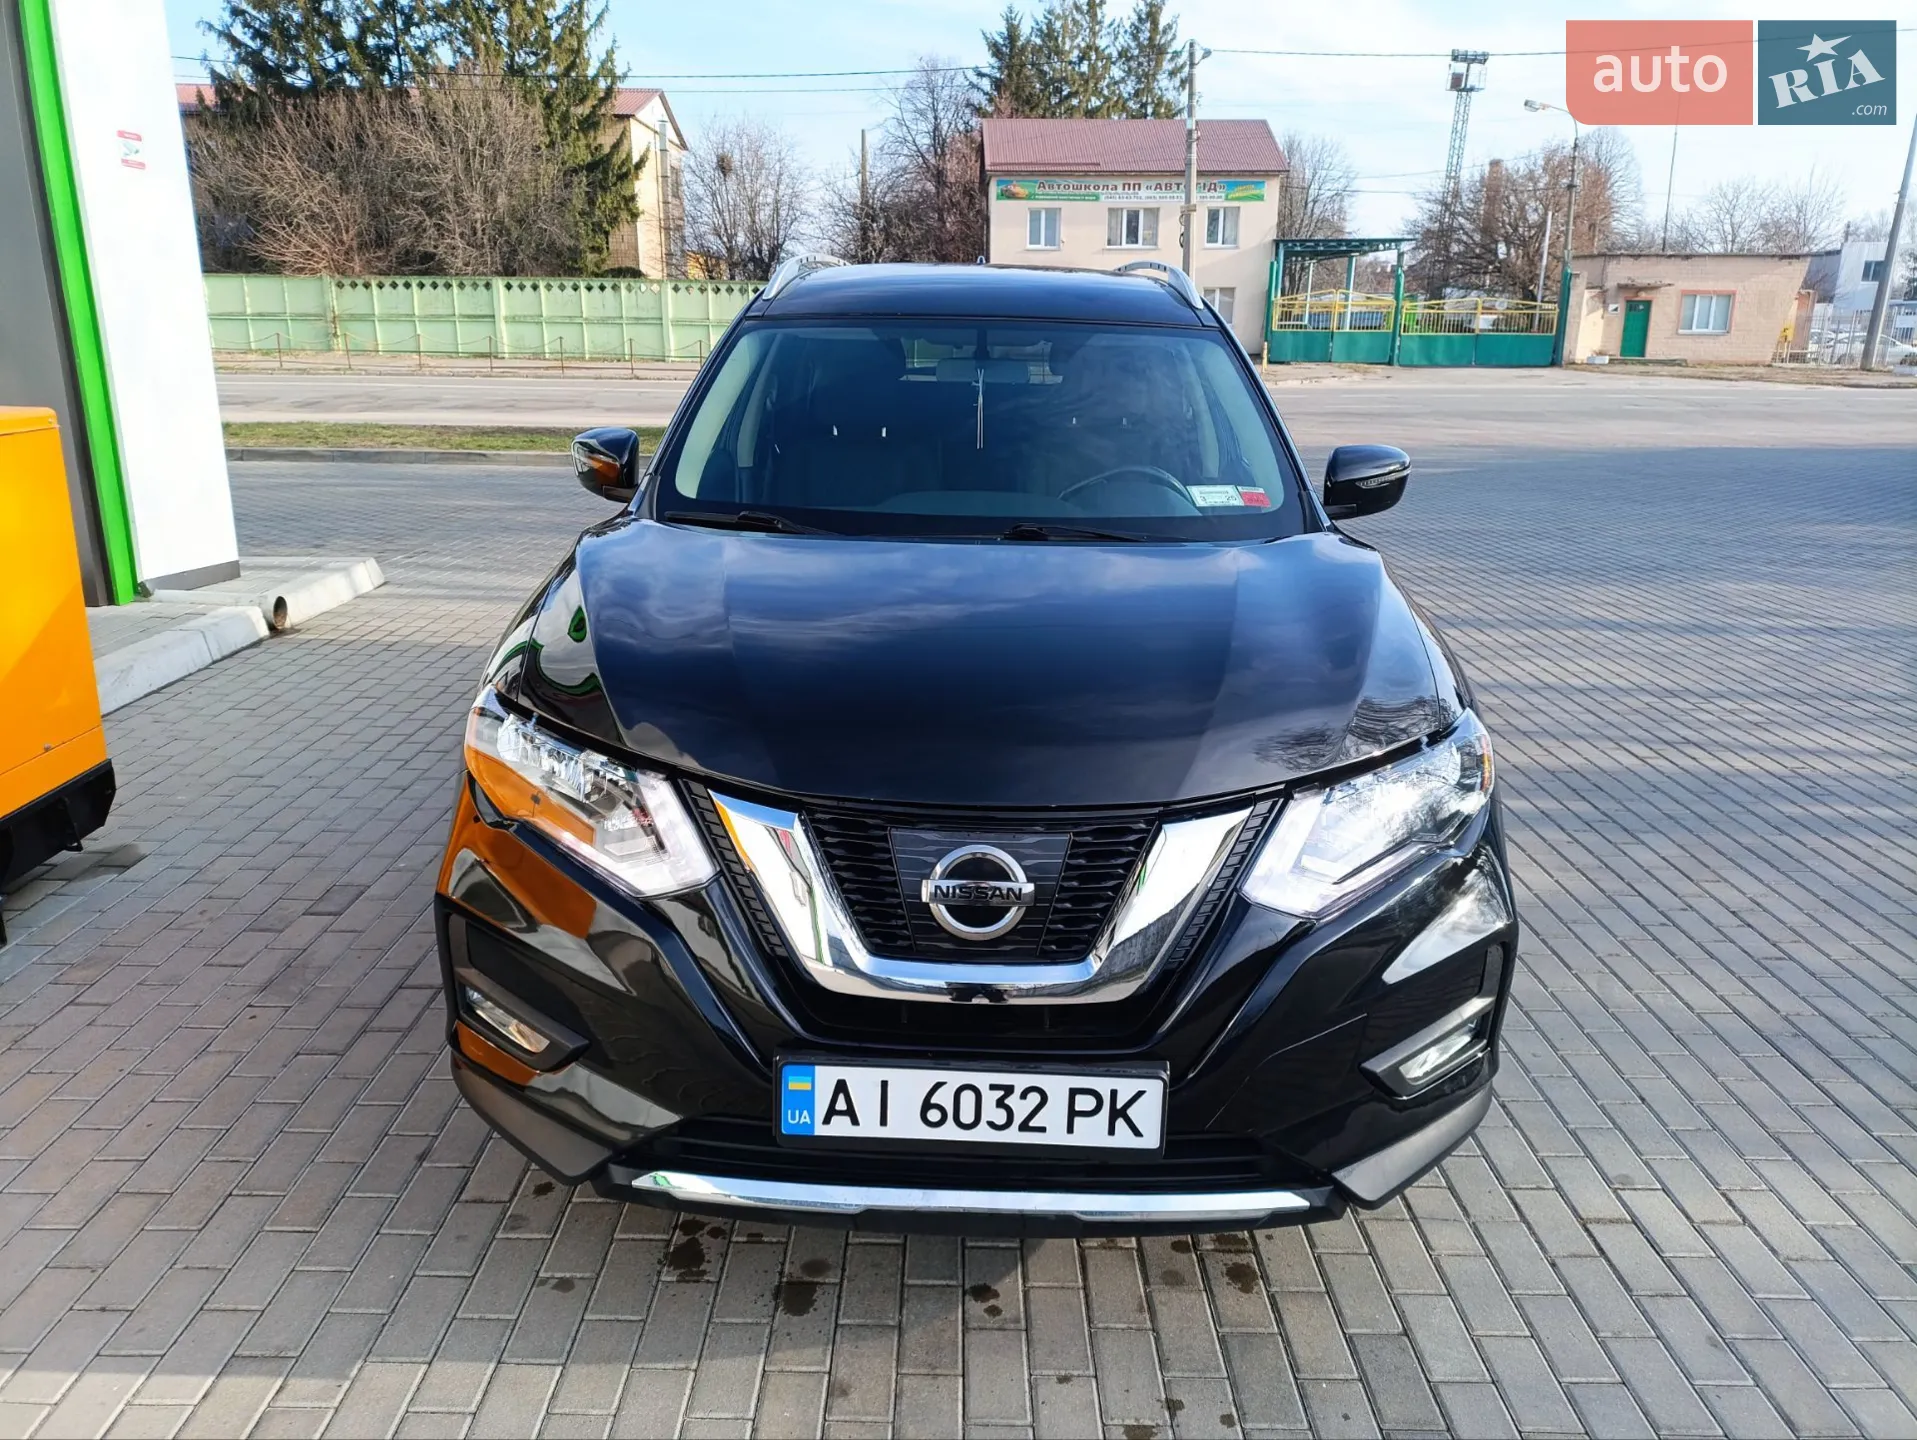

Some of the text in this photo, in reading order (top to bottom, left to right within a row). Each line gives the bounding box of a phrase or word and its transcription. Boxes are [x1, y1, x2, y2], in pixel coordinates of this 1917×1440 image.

[1037, 181, 1118, 191] Автошкола
[1122, 182, 1141, 191] ПП
[1146, 182, 1225, 193] «АВТГІД»
[934, 885, 1022, 901] NISSAN
[788, 1108, 811, 1124] UA
[919, 1081, 1049, 1133] 6032
[1066, 1087, 1147, 1138] PK
